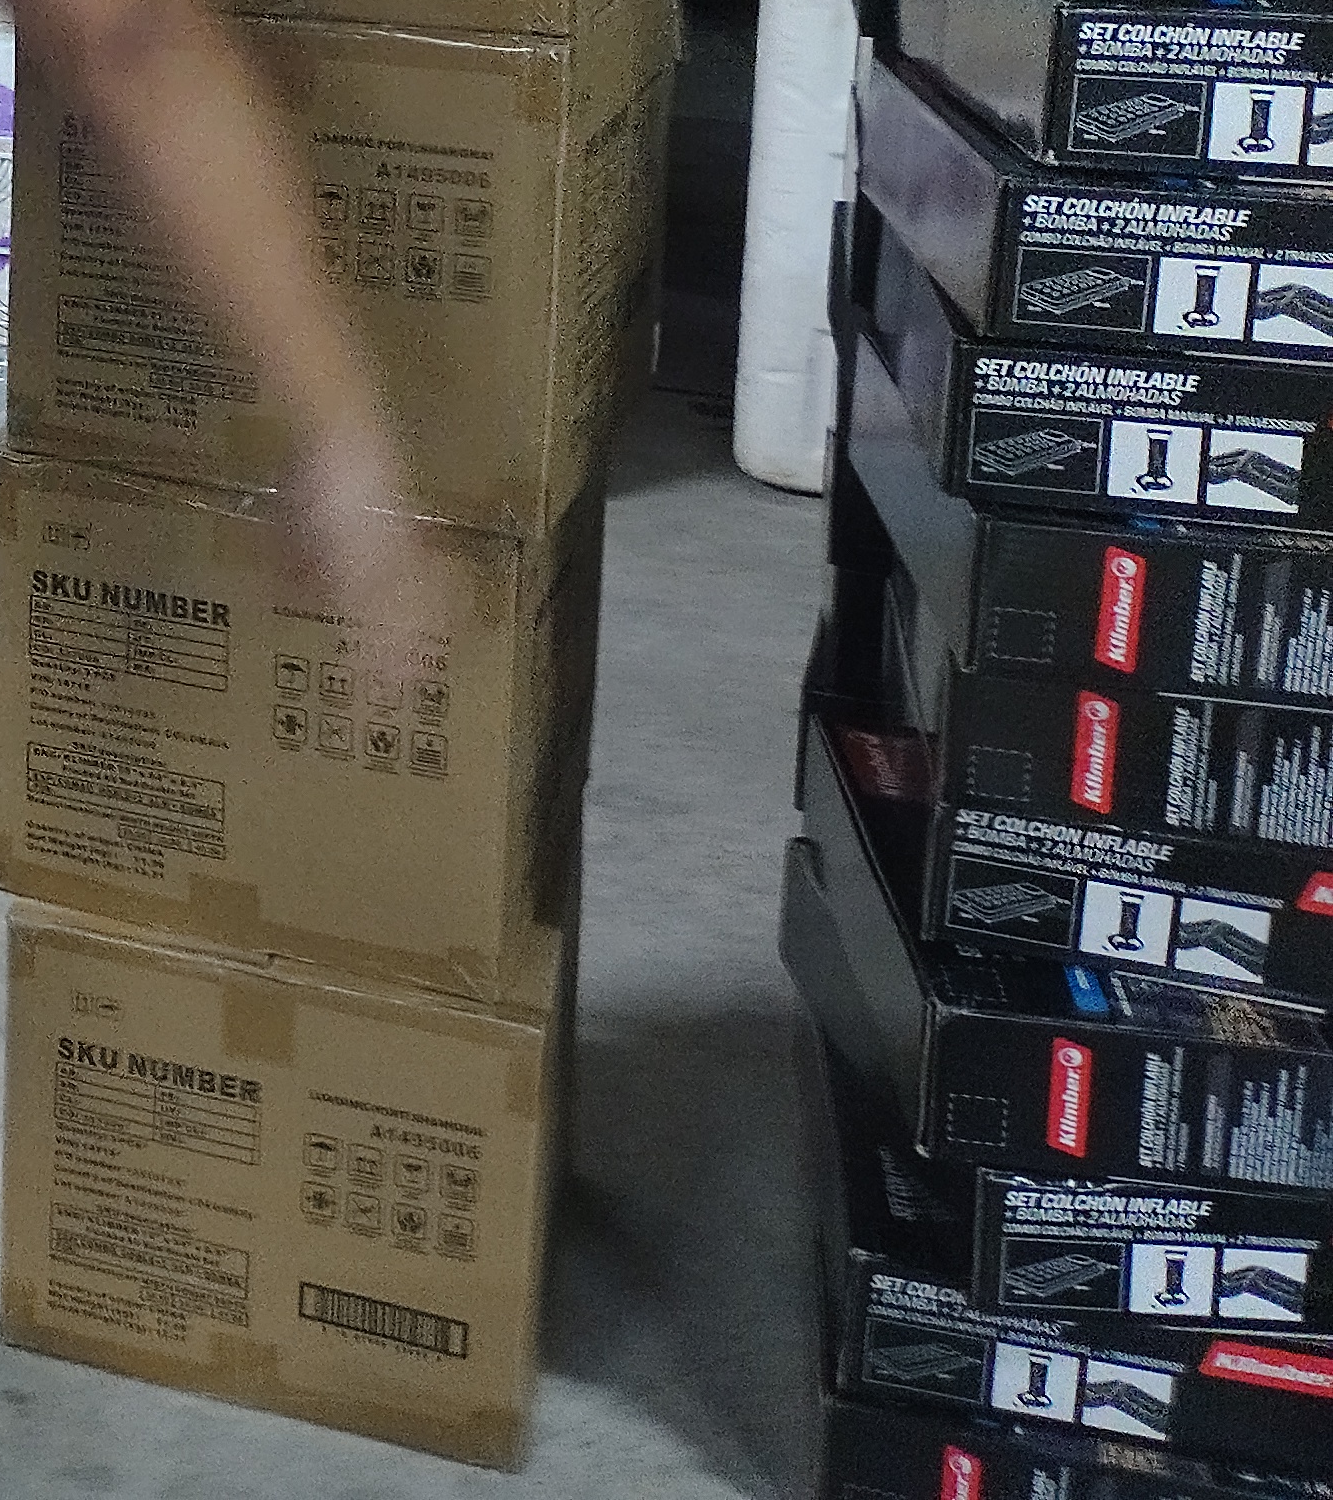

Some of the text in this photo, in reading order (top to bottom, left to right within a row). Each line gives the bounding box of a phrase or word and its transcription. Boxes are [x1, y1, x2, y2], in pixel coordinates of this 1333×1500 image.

[33, 570, 231, 628] SKU NUMBER
[1108, 578, 1133, 663] Klimber
[1084, 718, 1109, 803] Klimber
[57, 1037, 263, 1104] SKU NUMBER
[1058, 1066, 1082, 1147] Klimber
